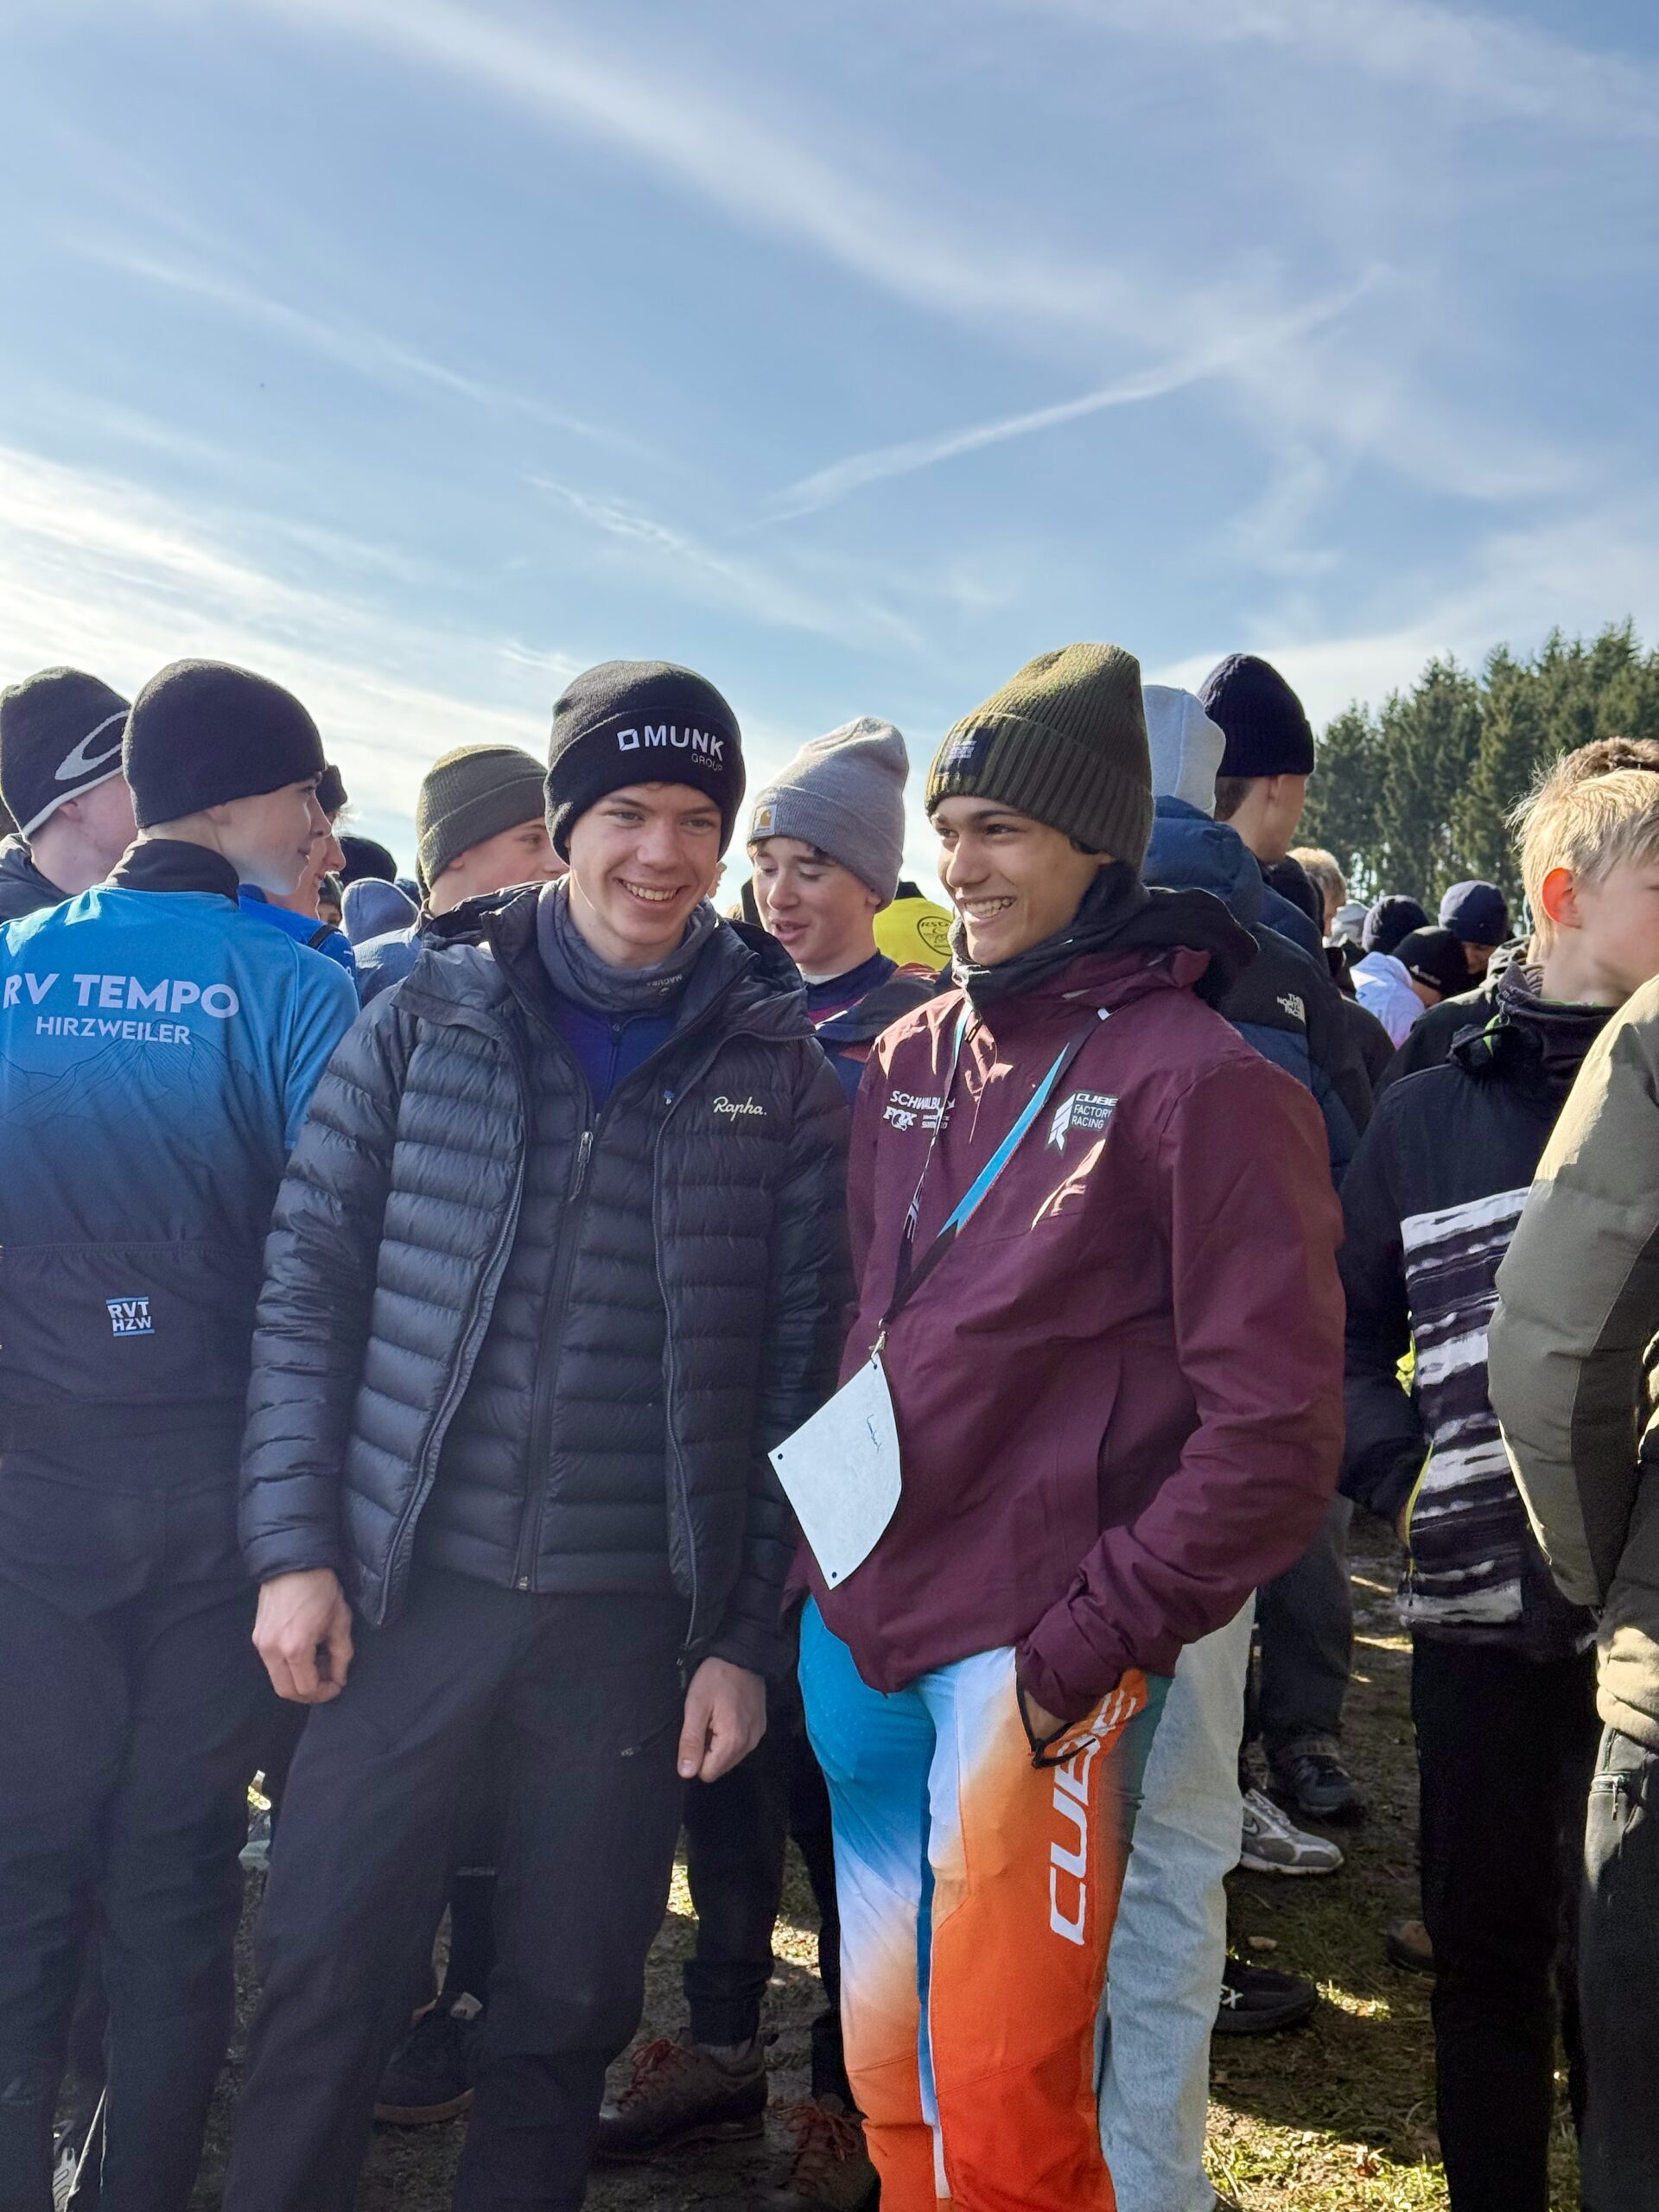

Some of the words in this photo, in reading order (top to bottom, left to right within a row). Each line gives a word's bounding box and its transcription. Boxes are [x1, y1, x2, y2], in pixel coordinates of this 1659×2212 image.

[644, 725, 724, 761] MUNK
[691, 753, 723, 772] GROUP
[3, 972, 60, 1009] RV
[73, 973, 239, 1019] TEMPO
[35, 1015, 191, 1045] HIRZWEILER
[1076, 1093, 1119, 1107] CUBE
[1073, 1104, 1112, 1118] FACTORY
[1071, 1116, 1104, 1129] RACING
[107, 1301, 149, 1319] RVT
[112, 1316, 151, 1332] HZW
